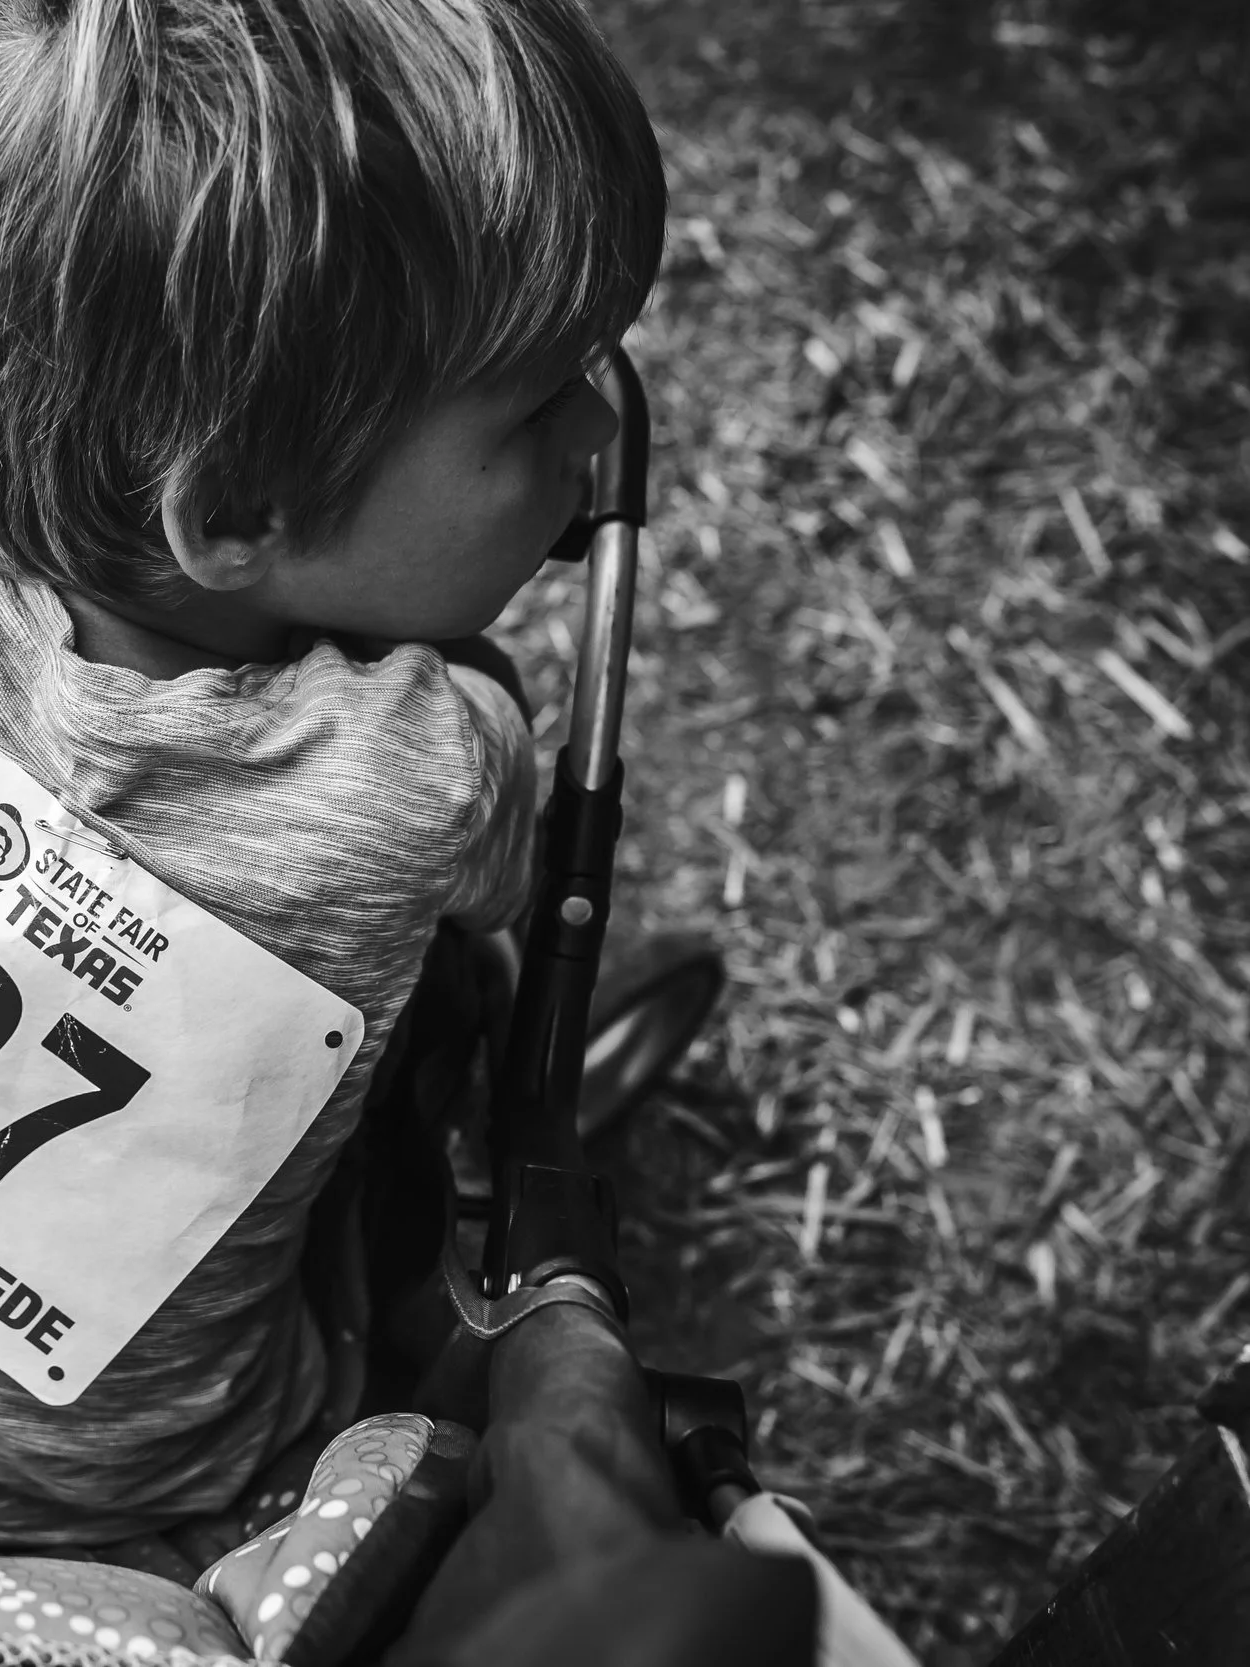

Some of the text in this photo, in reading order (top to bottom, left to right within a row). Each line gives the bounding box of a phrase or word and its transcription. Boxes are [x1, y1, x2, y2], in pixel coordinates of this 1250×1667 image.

[5, 883, 144, 1007] TEXAS
[35, 848, 170, 963] STATE FAIR
[72, 912, 101, 935] OF
